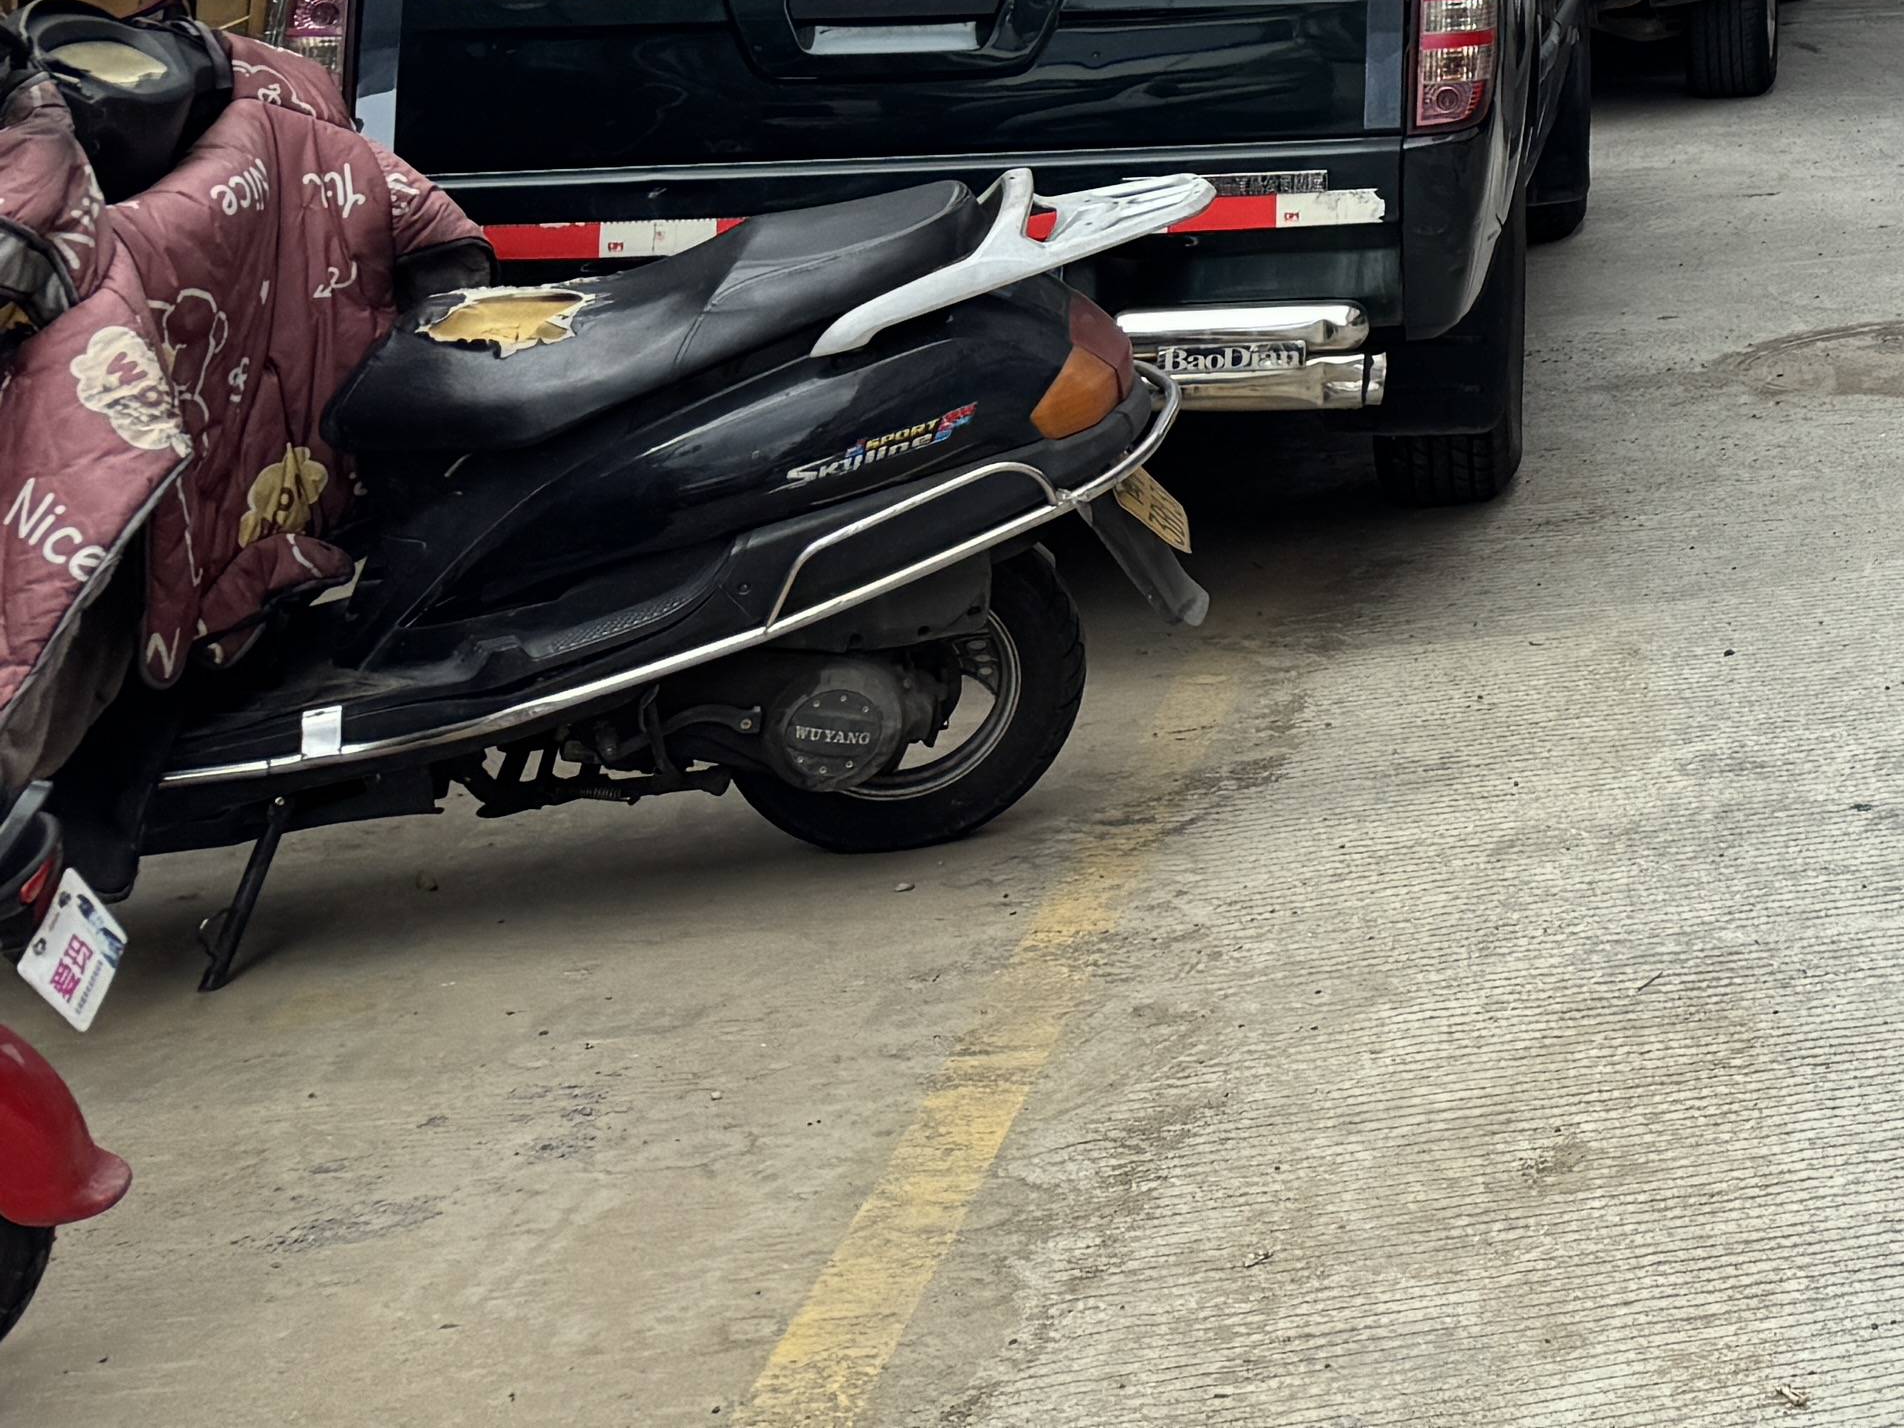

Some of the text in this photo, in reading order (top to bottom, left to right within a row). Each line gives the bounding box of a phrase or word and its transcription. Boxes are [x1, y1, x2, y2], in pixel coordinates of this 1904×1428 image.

[1164, 346, 1301, 372] BaoDian
[865, 417, 941, 451] SPORT
[784, 428, 936, 490] Skyline
[3, 478, 105, 583] Nice
[794, 725, 872, 745] WUYANG
